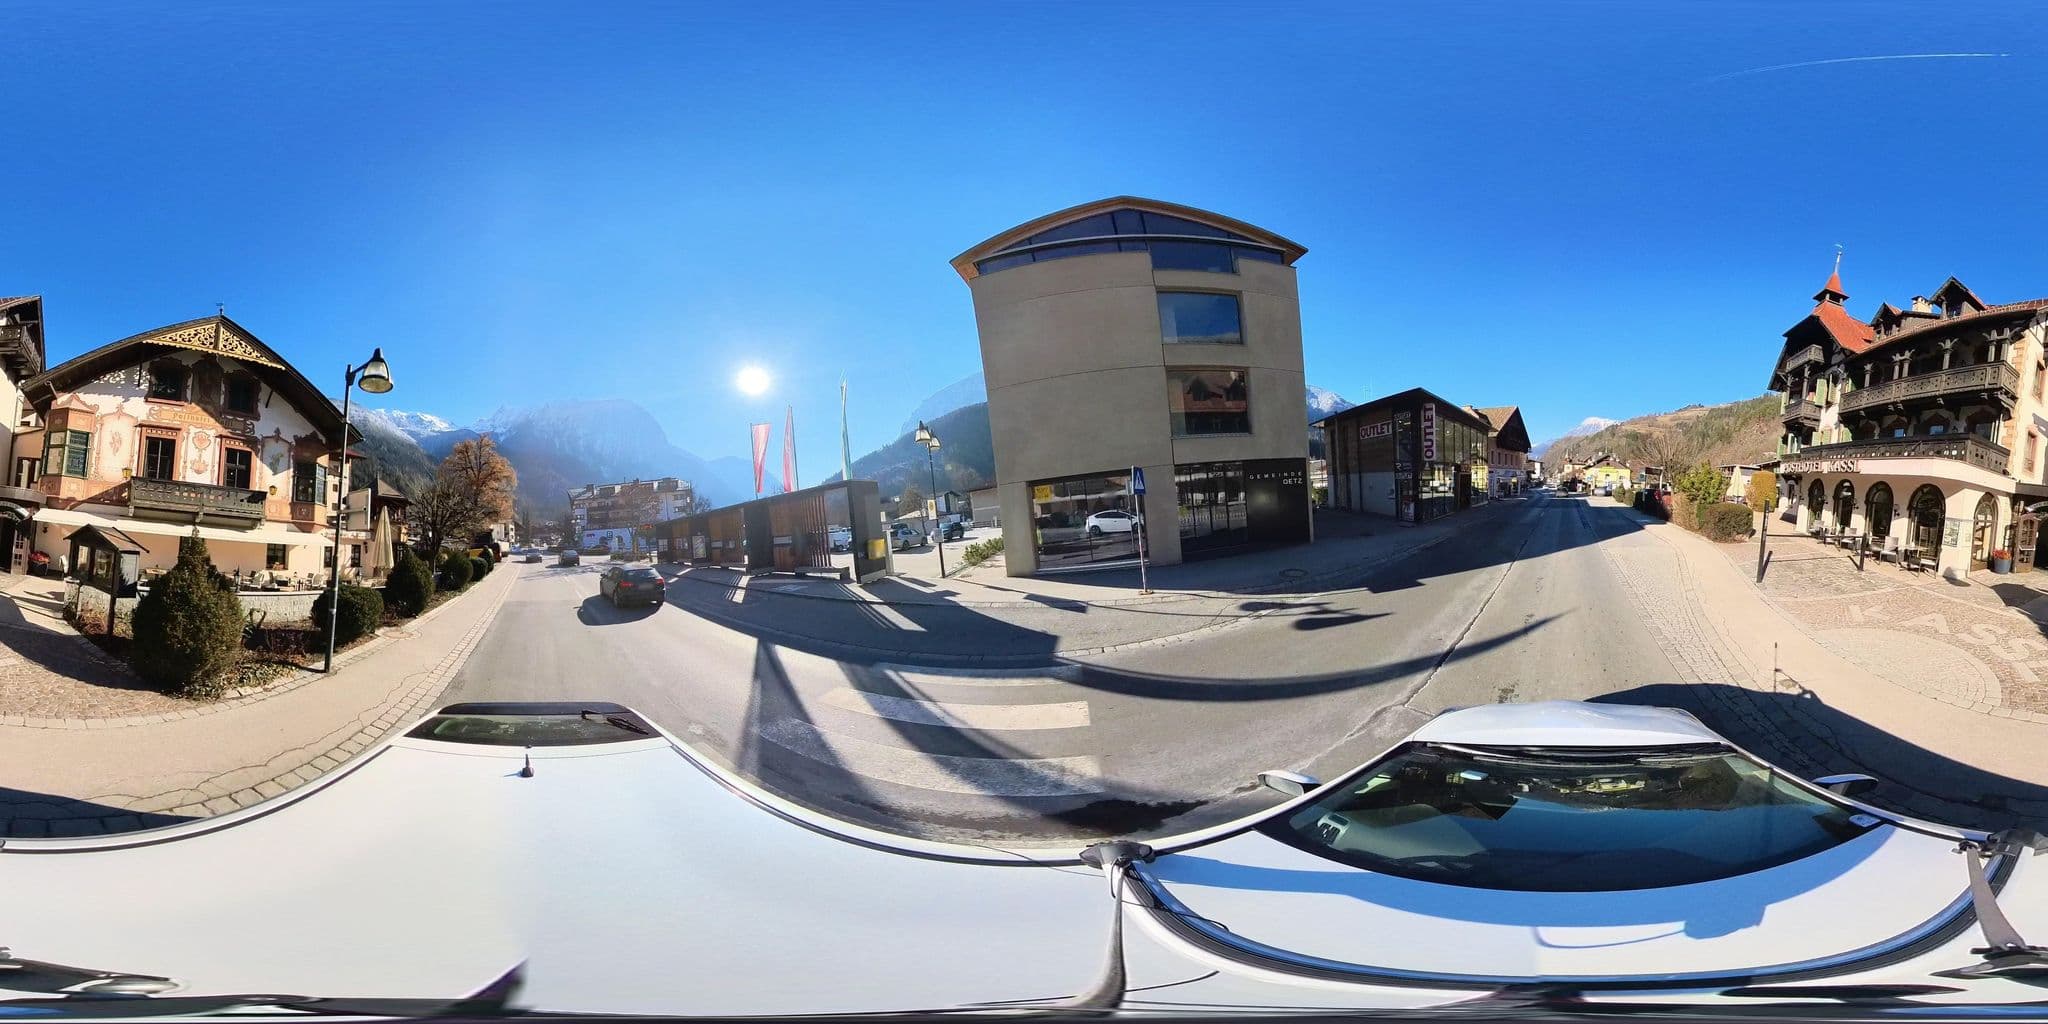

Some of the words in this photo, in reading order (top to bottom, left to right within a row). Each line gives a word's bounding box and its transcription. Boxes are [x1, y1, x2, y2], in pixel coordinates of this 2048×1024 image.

[1361, 422, 1391, 438] OUTLET
[1424, 406, 1434, 459] OUTLET
[1828, 459, 1860, 472] KASSL
[1249, 471, 1302, 479] GEMEINDE
